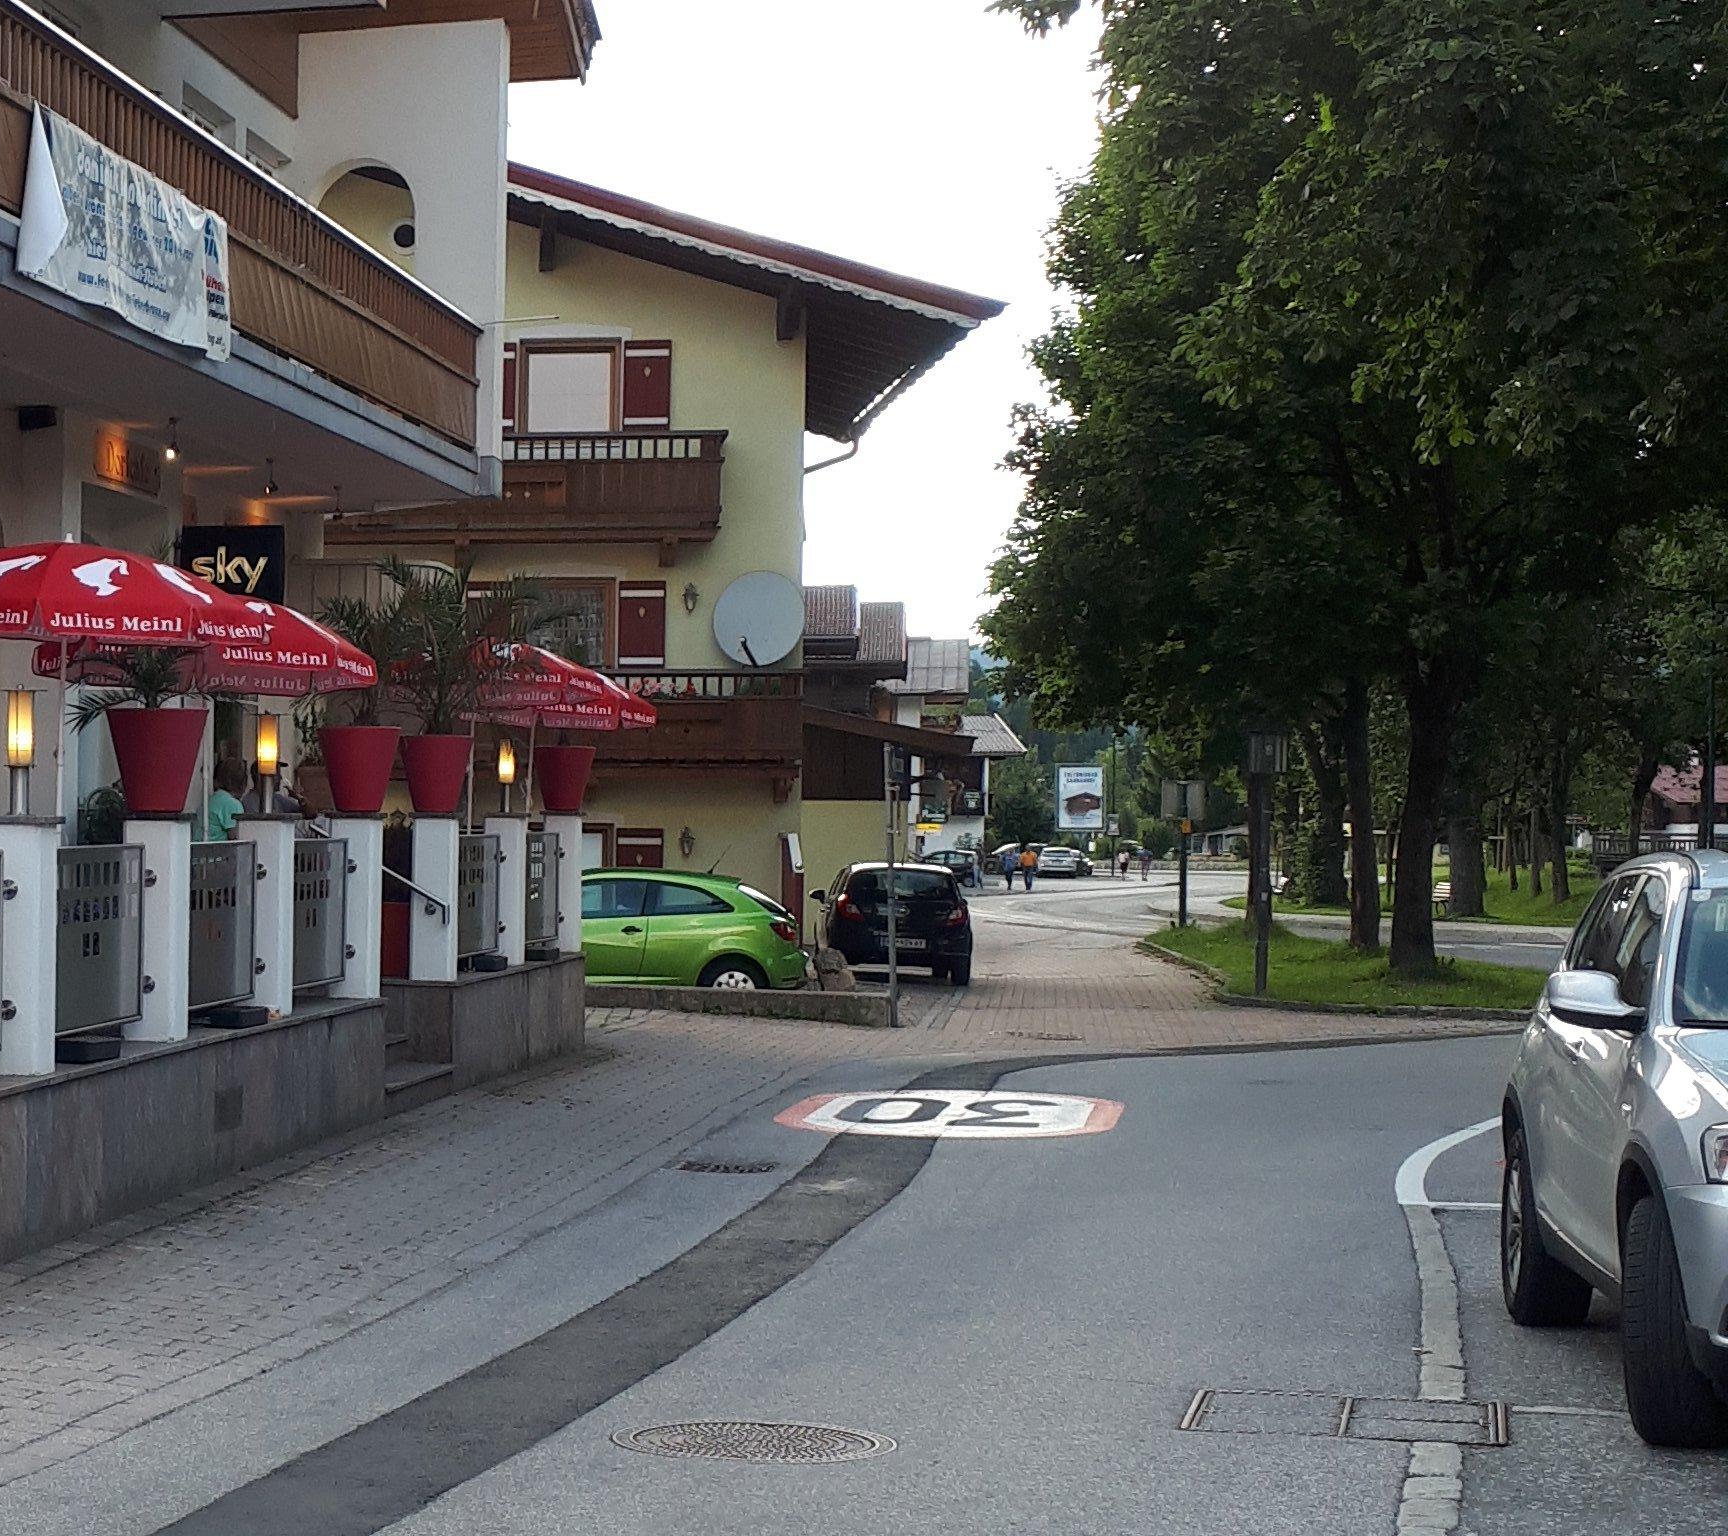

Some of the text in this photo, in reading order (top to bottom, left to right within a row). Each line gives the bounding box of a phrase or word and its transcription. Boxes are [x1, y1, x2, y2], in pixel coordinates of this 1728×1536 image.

[191, 546, 268, 593] sky
[50, 612, 182, 632] Julius Meinl
[222, 647, 328, 666] Julius Meinl
[576, 704, 612, 715] Meinl
[834, 1098, 1059, 1128] 30
